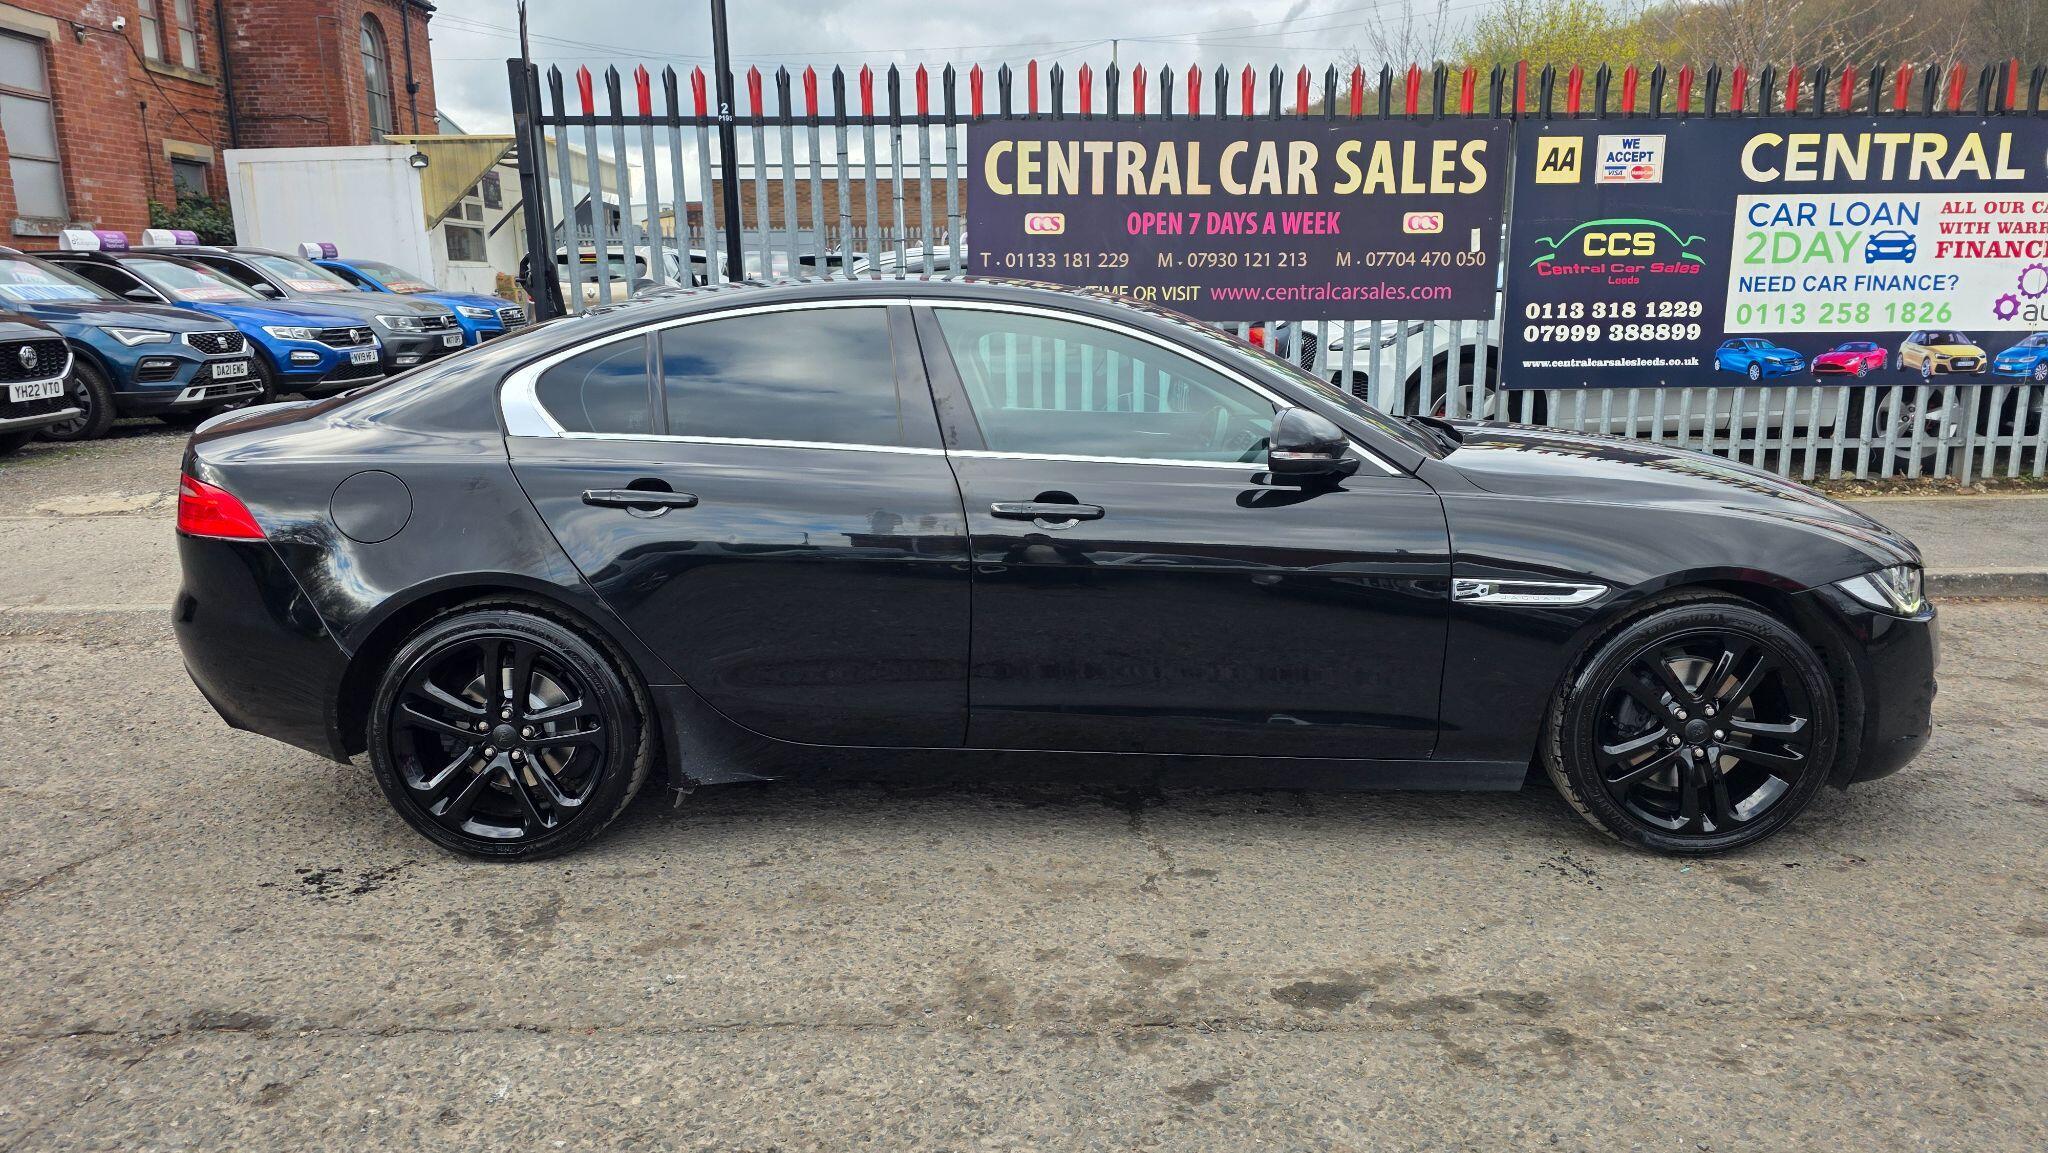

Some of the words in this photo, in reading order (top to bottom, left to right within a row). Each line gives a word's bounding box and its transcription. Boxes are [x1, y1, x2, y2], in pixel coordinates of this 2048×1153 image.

[720, 102, 729, 114] 2
[1622, 138, 1640, 149] WE
[1541, 147, 1576, 171] AA
[1606, 151, 1654, 162] ACCEPT
[1741, 132, 2026, 183] CENTRAL
[984, 140, 1211, 195] CENTRAL
[1219, 140, 1318, 195] CAR
[1334, 139, 1488, 195] SALES
[1748, 202, 1818, 228] CAR
[1829, 202, 1921, 227] LOAN
[1940, 201, 1977, 214] ALL
[1984, 201, 2025, 214] OUR
[1029, 216, 1061, 232] CCS
[1128, 212, 1183, 235] OPEN
[1189, 212, 1201, 235] 7
[1206, 212, 1258, 235] DAYS
[1262, 212, 1277, 234] A
[1282, 212, 1341, 234] WEEK
[1408, 215, 1439, 230] CCS
[1939, 221, 1991, 234] WITH
[1583, 231, 1656, 257] CCS
[1744, 231, 1861, 264] 2DAY
[1006, 252, 1056, 268] 01133
[1063, 252, 1090, 268] 181
[1098, 252, 1129, 268] 229
[1187, 252, 1237, 268] 07930
[1244, 252, 1270, 267] 121
[1278, 252, 1308, 267] 213
[1365, 251, 1416, 267] 07704
[1421, 251, 1451, 267] 470
[1456, 251, 1486, 267] 050
[1537, 262, 1605, 276] Central
[1611, 263, 1645, 274] Car
[1650, 262, 1700, 274] Sales
[1608, 276, 1639, 285] Leeds
[1738, 275, 1797, 292] NEED
[1803, 275, 1848, 292] CAR
[1854, 274, 1959, 292] FINANCE?
[1133, 286, 1157, 301] OR
[1161, 286, 1202, 301] VISIT
[1210, 282, 1452, 301] www.centralcarsales.com
[1525, 302, 1585, 319] 0113
[1591, 301, 1637, 318] 318
[1645, 301, 1703, 318] 1229
[1736, 303, 1807, 325] 0113
[1818, 302, 1871, 324] 258
[1885, 301, 1953, 324] 1826
[1523, 324, 1601, 342] 07999
[1608, 323, 1702, 341] 388899
[1522, 357, 1700, 368] www.centralcarsalesleeds.co.uk
[14, 384, 40, 399] YH22
